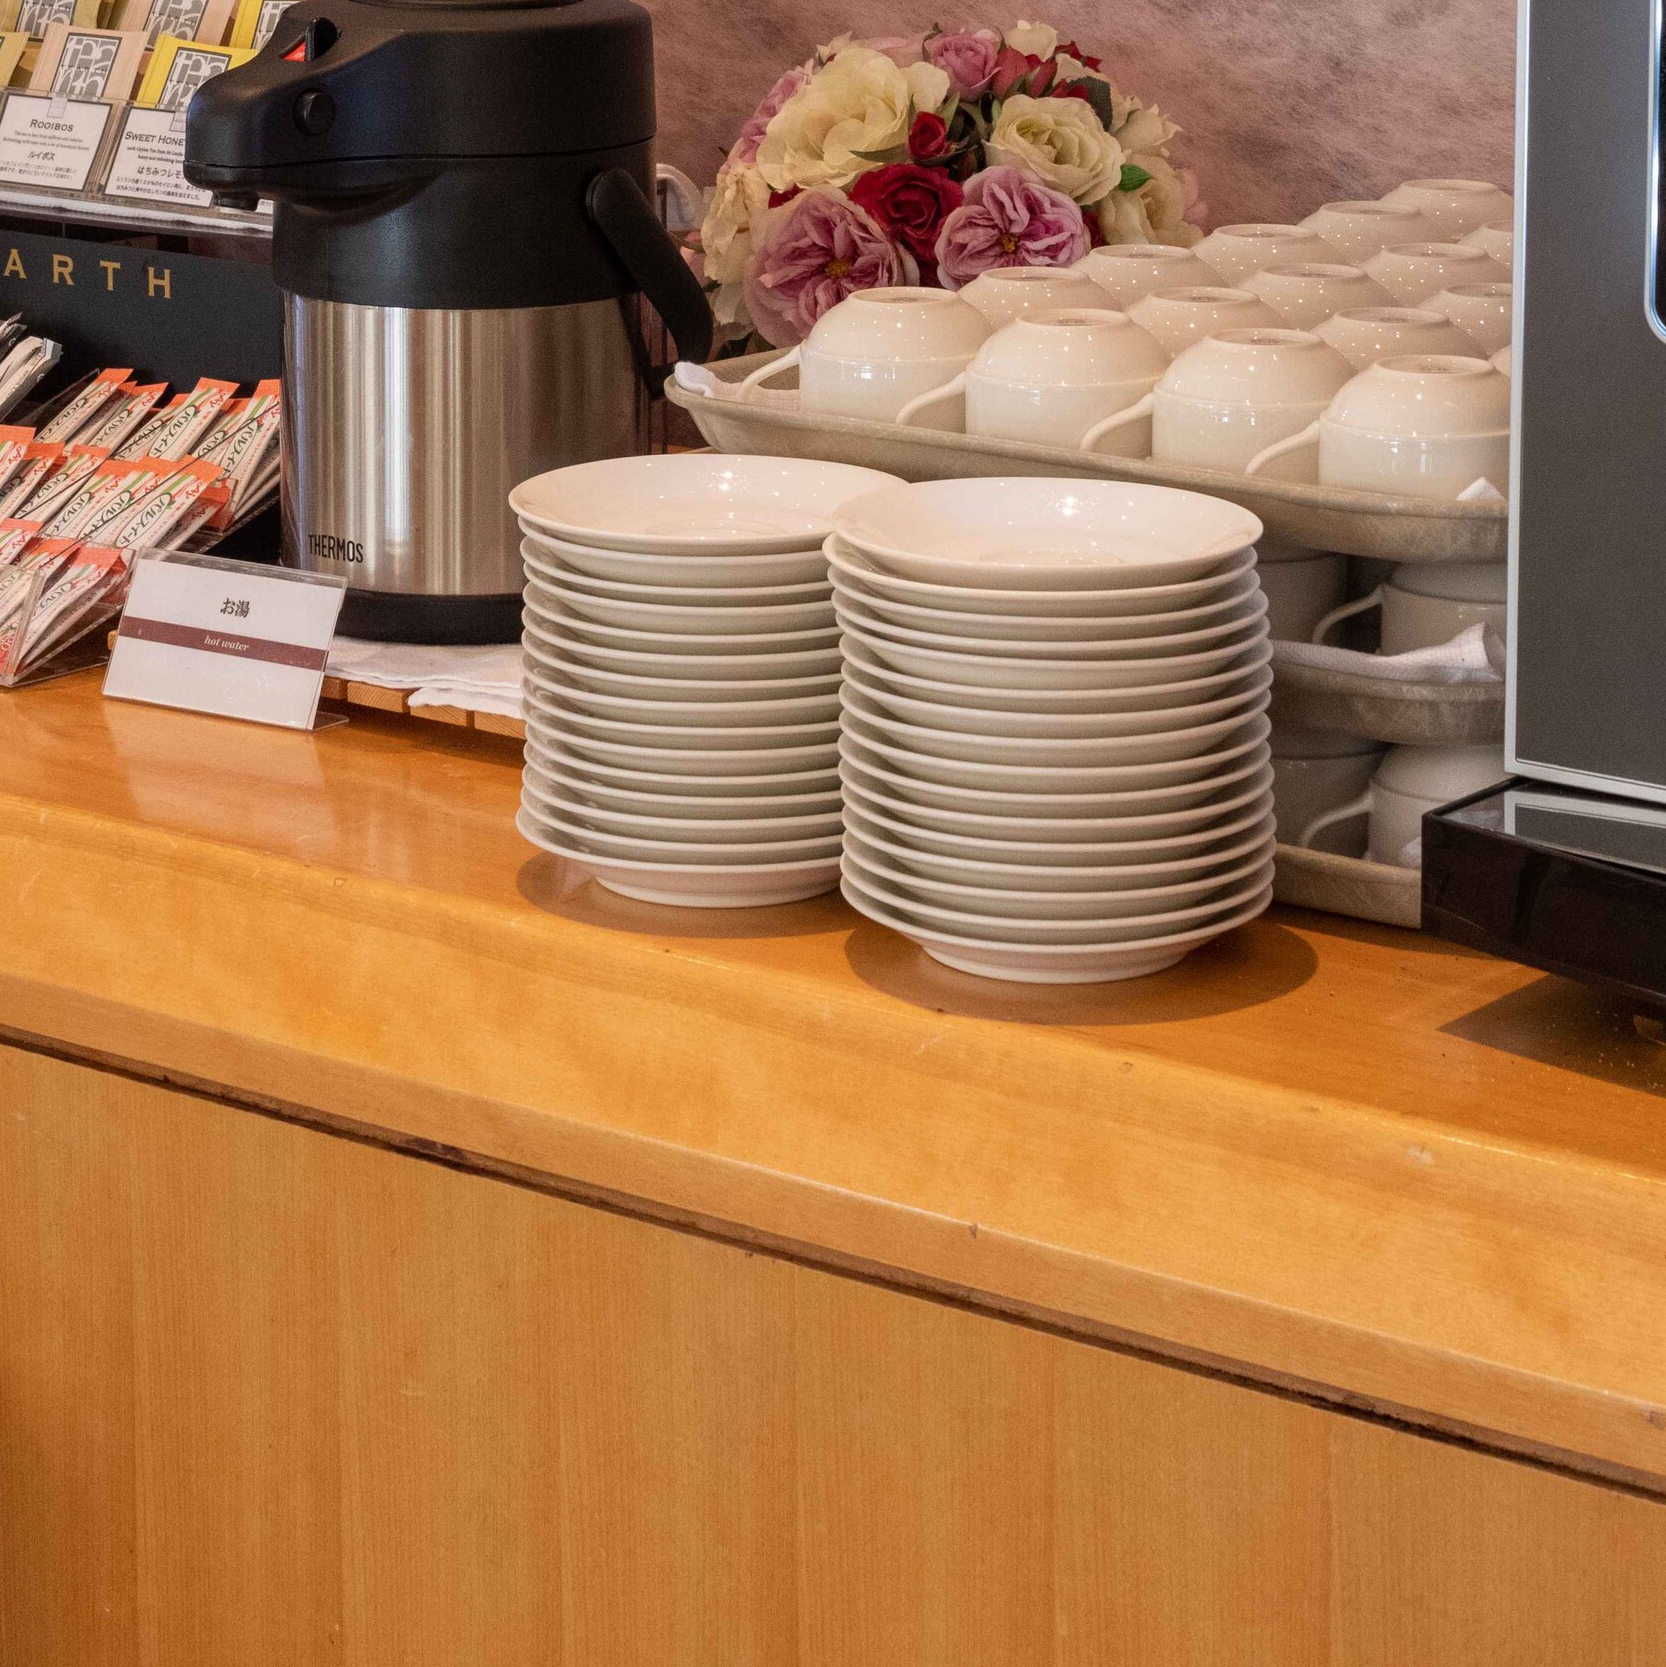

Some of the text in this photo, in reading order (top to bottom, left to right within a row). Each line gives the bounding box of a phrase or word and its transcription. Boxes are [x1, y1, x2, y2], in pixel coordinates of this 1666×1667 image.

[29, 119, 74, 132] ROOIBOS
[125, 131, 184, 147] SWEET HONE
[153, 407, 193, 457] パルスイート
[119, 496, 166, 545] パルスイート
[307, 532, 364, 564] THERMOS
[220, 596, 251, 619] お湯
[203, 633, 250, 653] hot water
